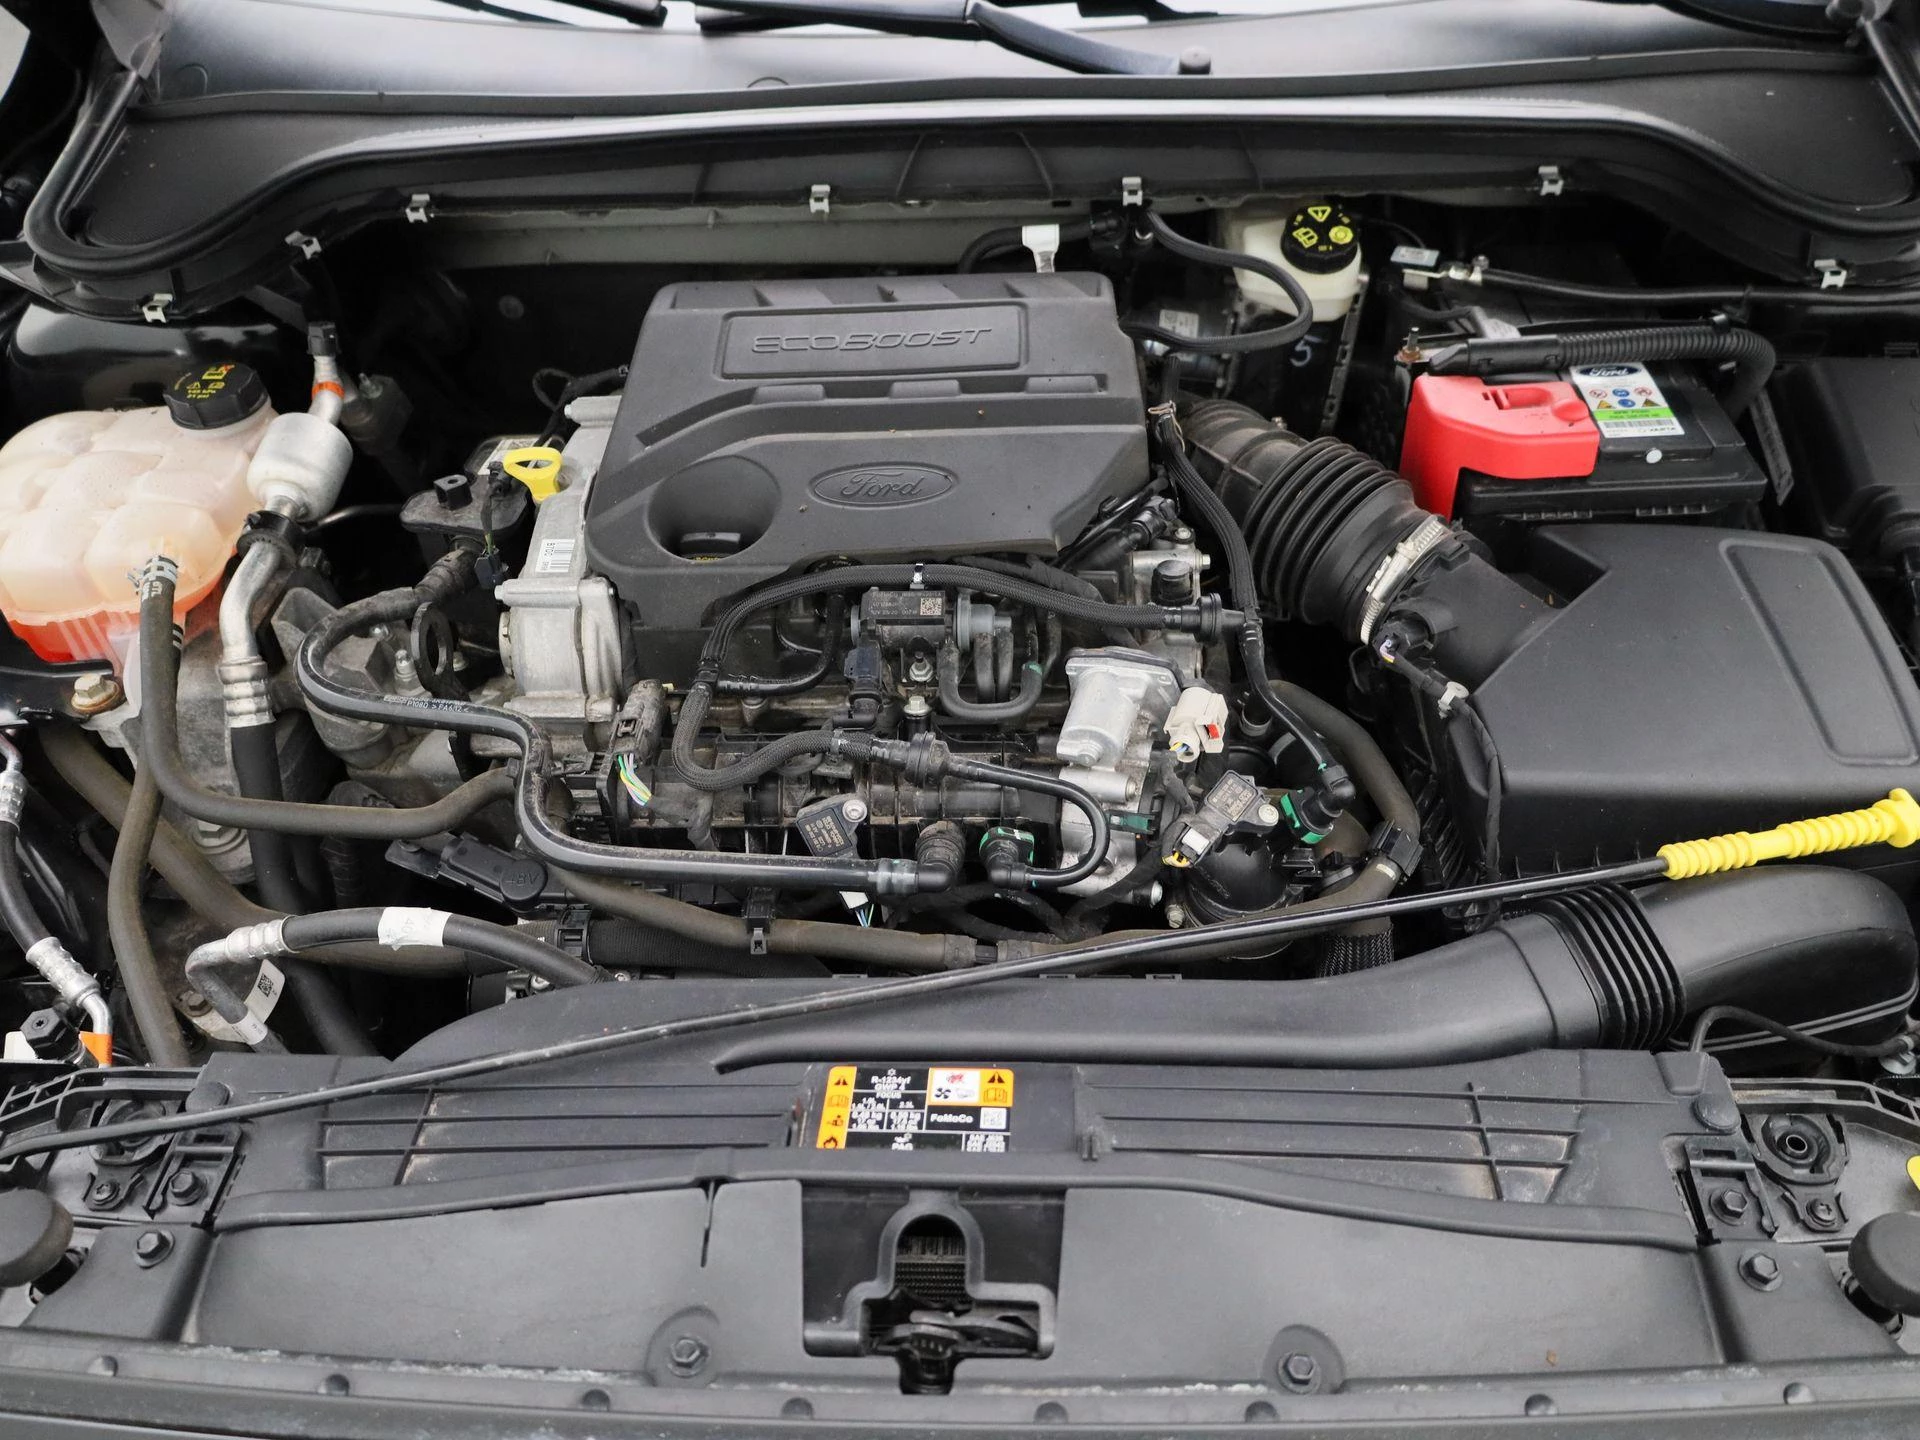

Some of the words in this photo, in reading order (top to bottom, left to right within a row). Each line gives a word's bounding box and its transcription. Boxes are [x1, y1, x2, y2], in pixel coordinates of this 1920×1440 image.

[752, 326, 992, 354] ECOBOOST
[1589, 367, 1630, 378] Ford
[840, 471, 926, 499] Ford
[871, 1076, 912, 1084] R-1234yf
[874, 1083, 898, 1091] GWP
[876, 1091, 902, 1099] FOCUS
[930, 1113, 974, 1124] FoMoCo
